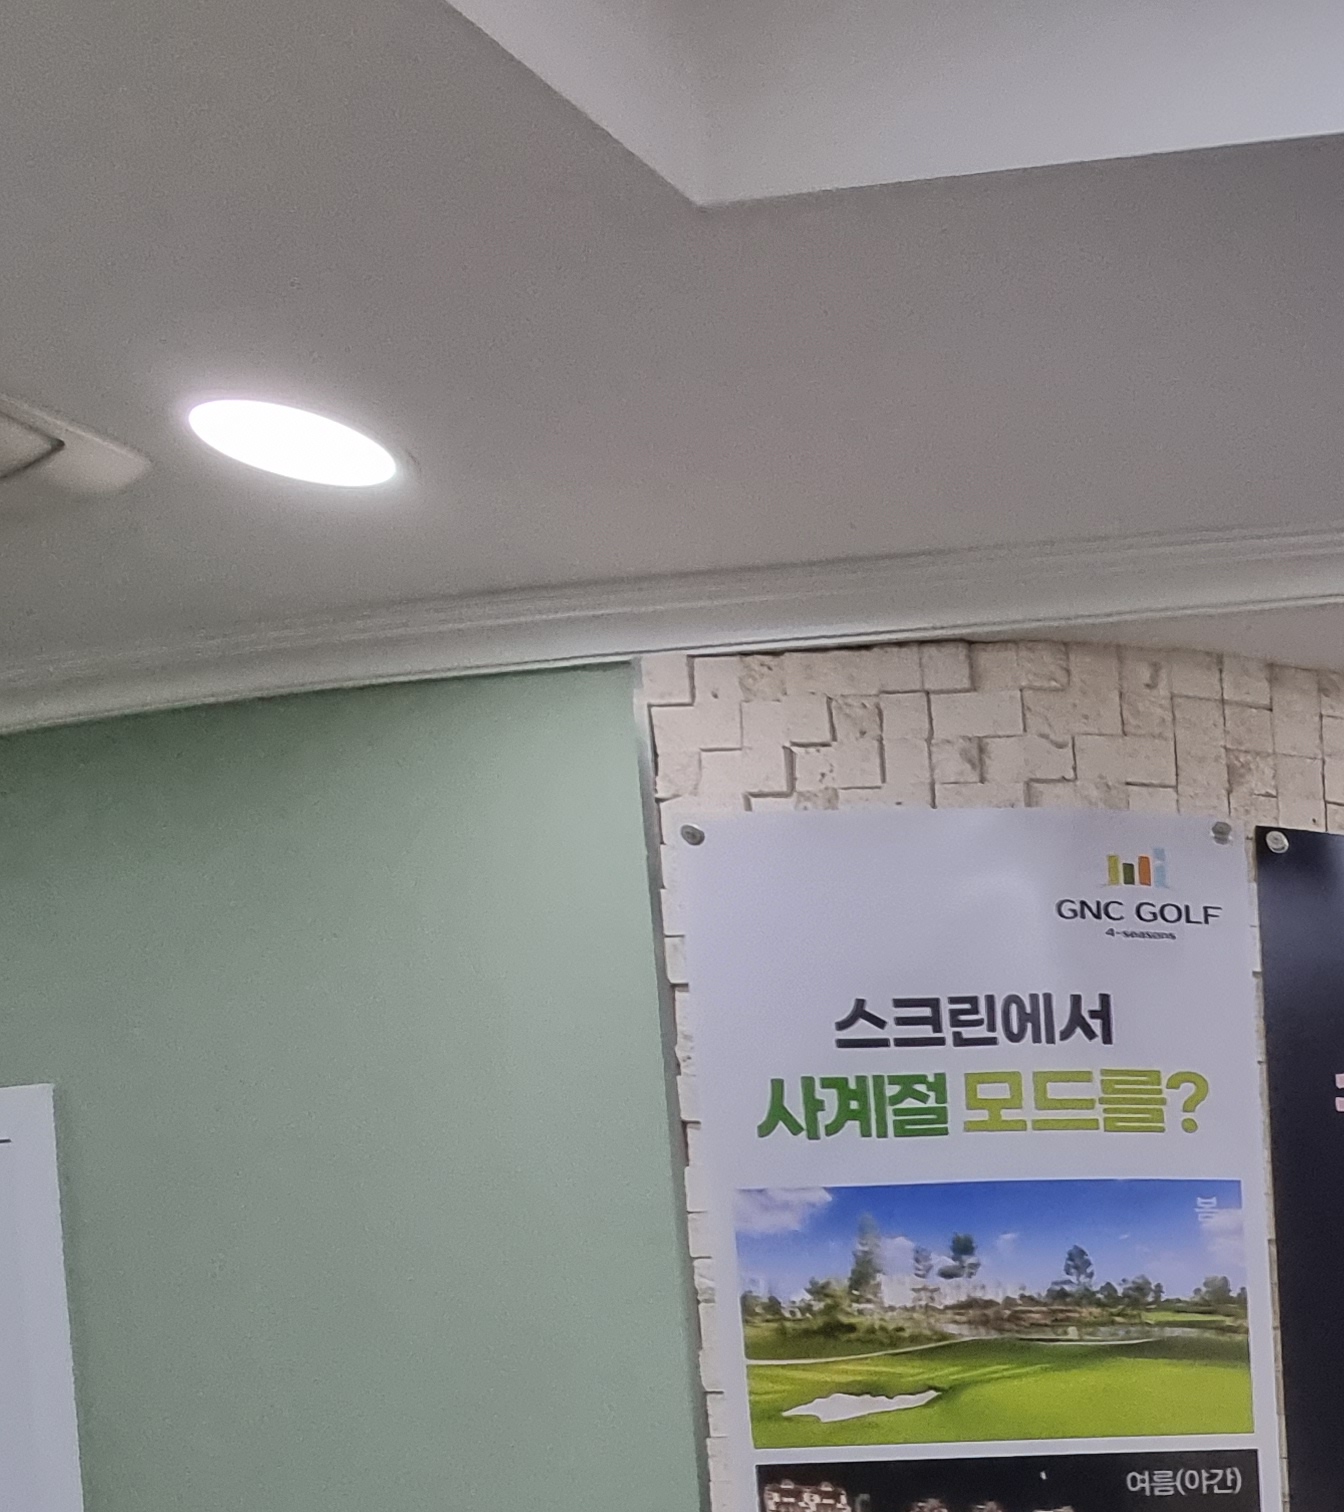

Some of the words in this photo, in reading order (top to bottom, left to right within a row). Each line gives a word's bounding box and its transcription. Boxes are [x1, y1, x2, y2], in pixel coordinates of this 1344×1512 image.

[1056, 899, 1125, 921] GNC
[1135, 902, 1222, 925] GOLF
[833, 991, 1115, 1049] 스크린에서
[757, 1072, 949, 1139] 사계절
[963, 1070, 1209, 1132] 모드를?
[1126, 1467, 1242, 1497] 여름(야간)
